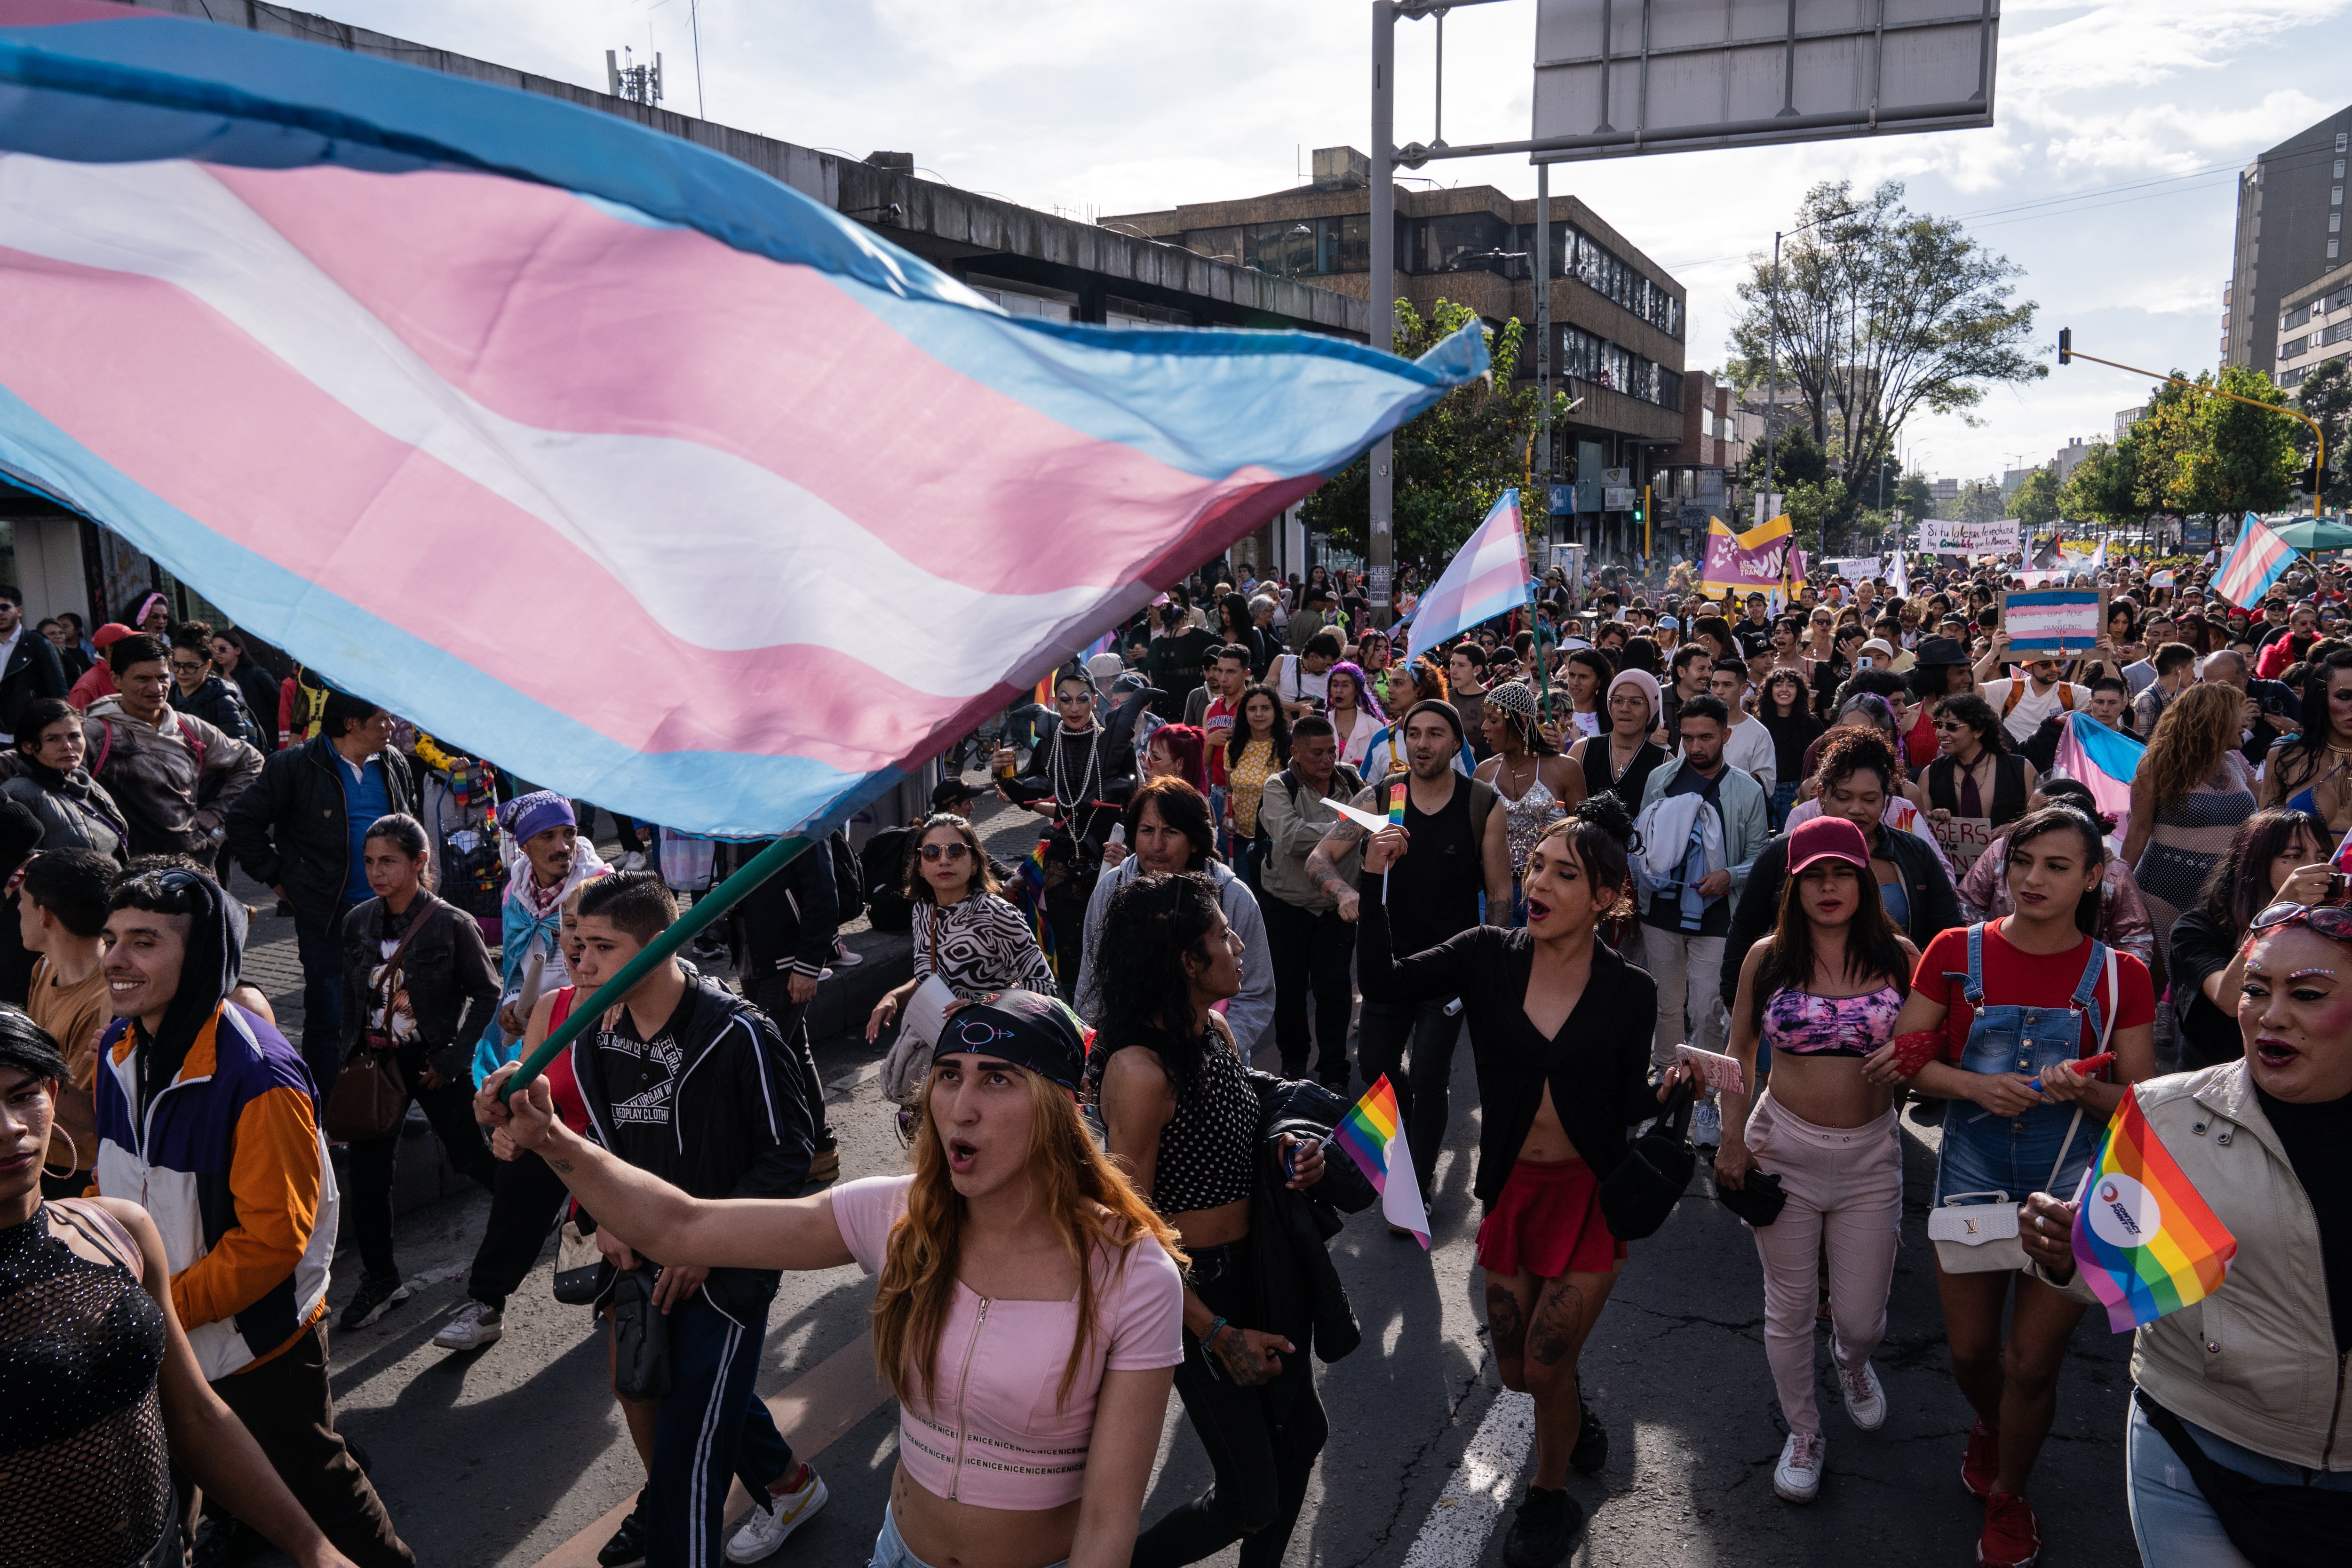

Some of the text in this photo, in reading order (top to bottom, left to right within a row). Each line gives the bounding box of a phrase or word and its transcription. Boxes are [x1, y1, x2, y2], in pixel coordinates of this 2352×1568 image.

[1952, 525, 1980, 542] Iglesia
[1847, 559, 1875, 567] GRATIS
[2043, 640, 2081, 649] DIENTES
[1939, 842, 1958, 851] the
[638, 1086, 664, 1107] URBAN
[616, 1107, 642, 1119] REDPLAY
[2116, 1202, 2142, 1234] CONTACT
